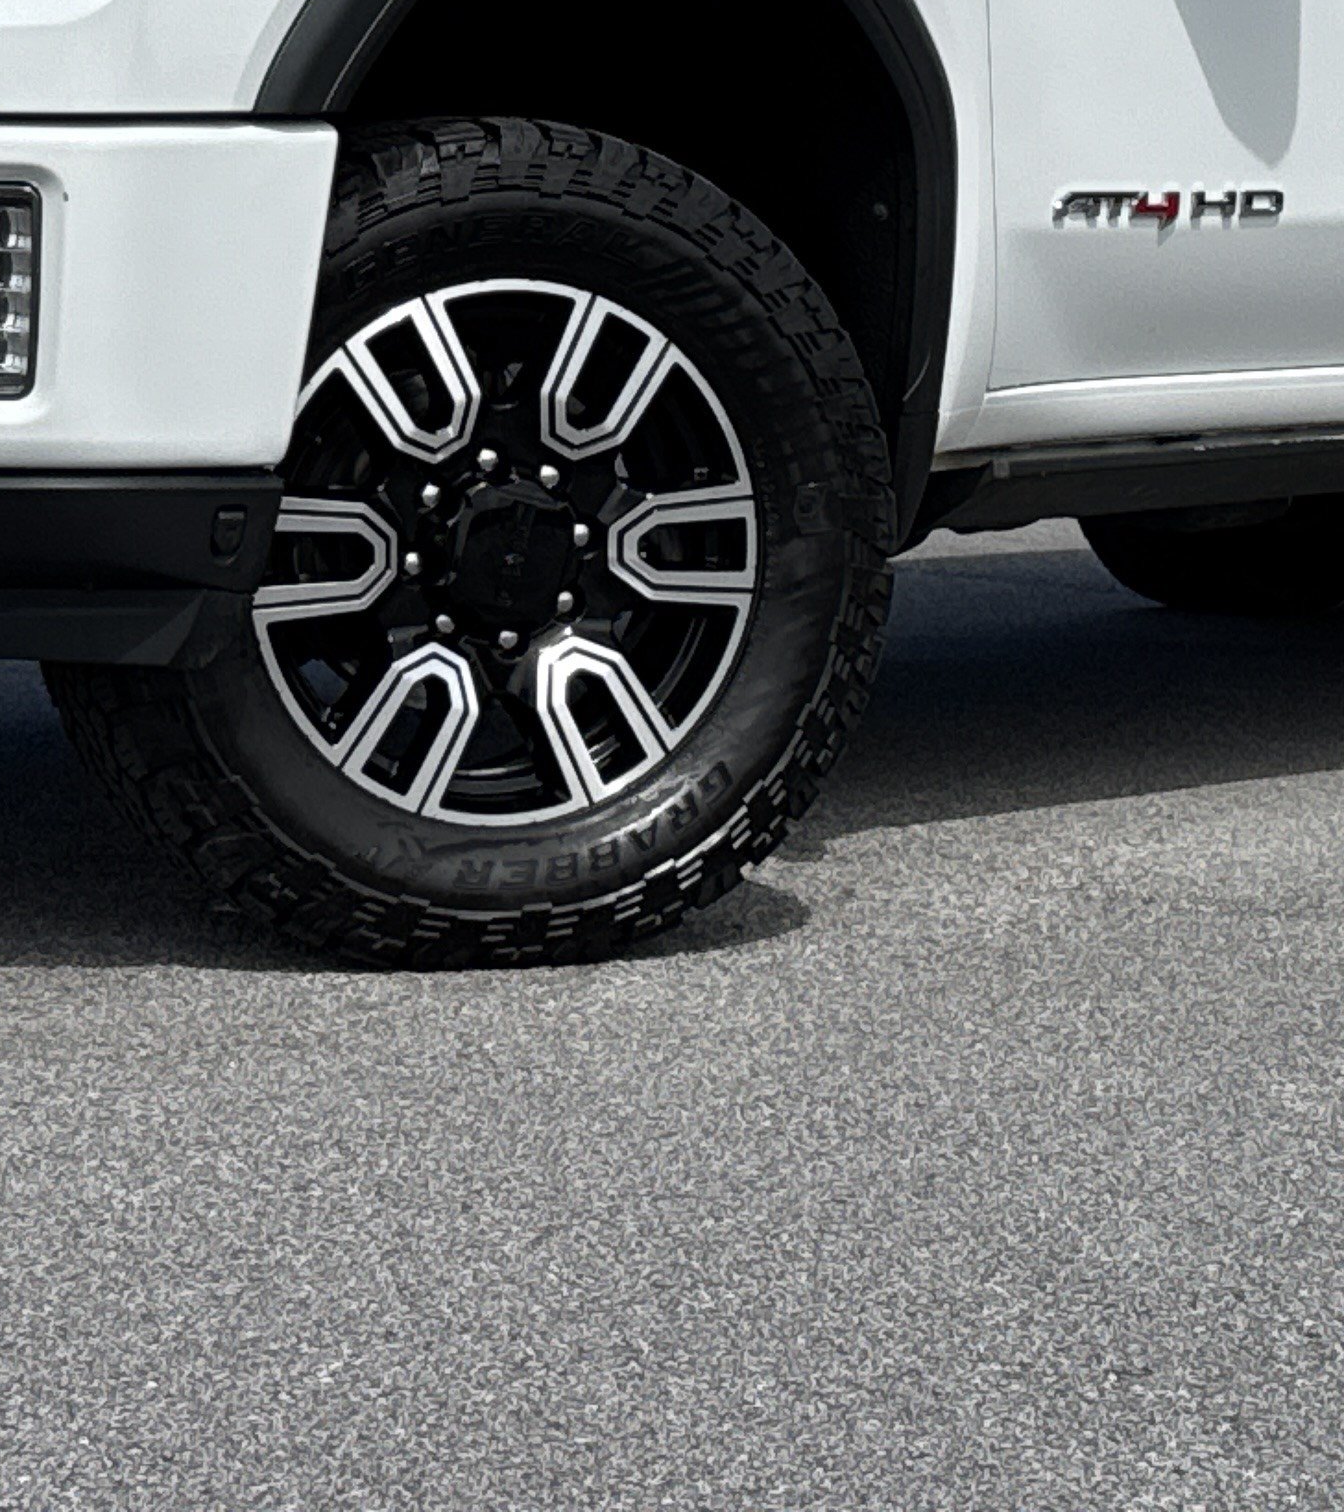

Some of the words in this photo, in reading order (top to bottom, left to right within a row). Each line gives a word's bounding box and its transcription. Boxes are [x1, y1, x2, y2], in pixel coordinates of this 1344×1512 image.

[339, 210, 642, 300] GENERAL
[1052, 190, 1181, 231] AT4
[1190, 189, 1284, 222] HD
[453, 760, 734, 891] GRABBER
